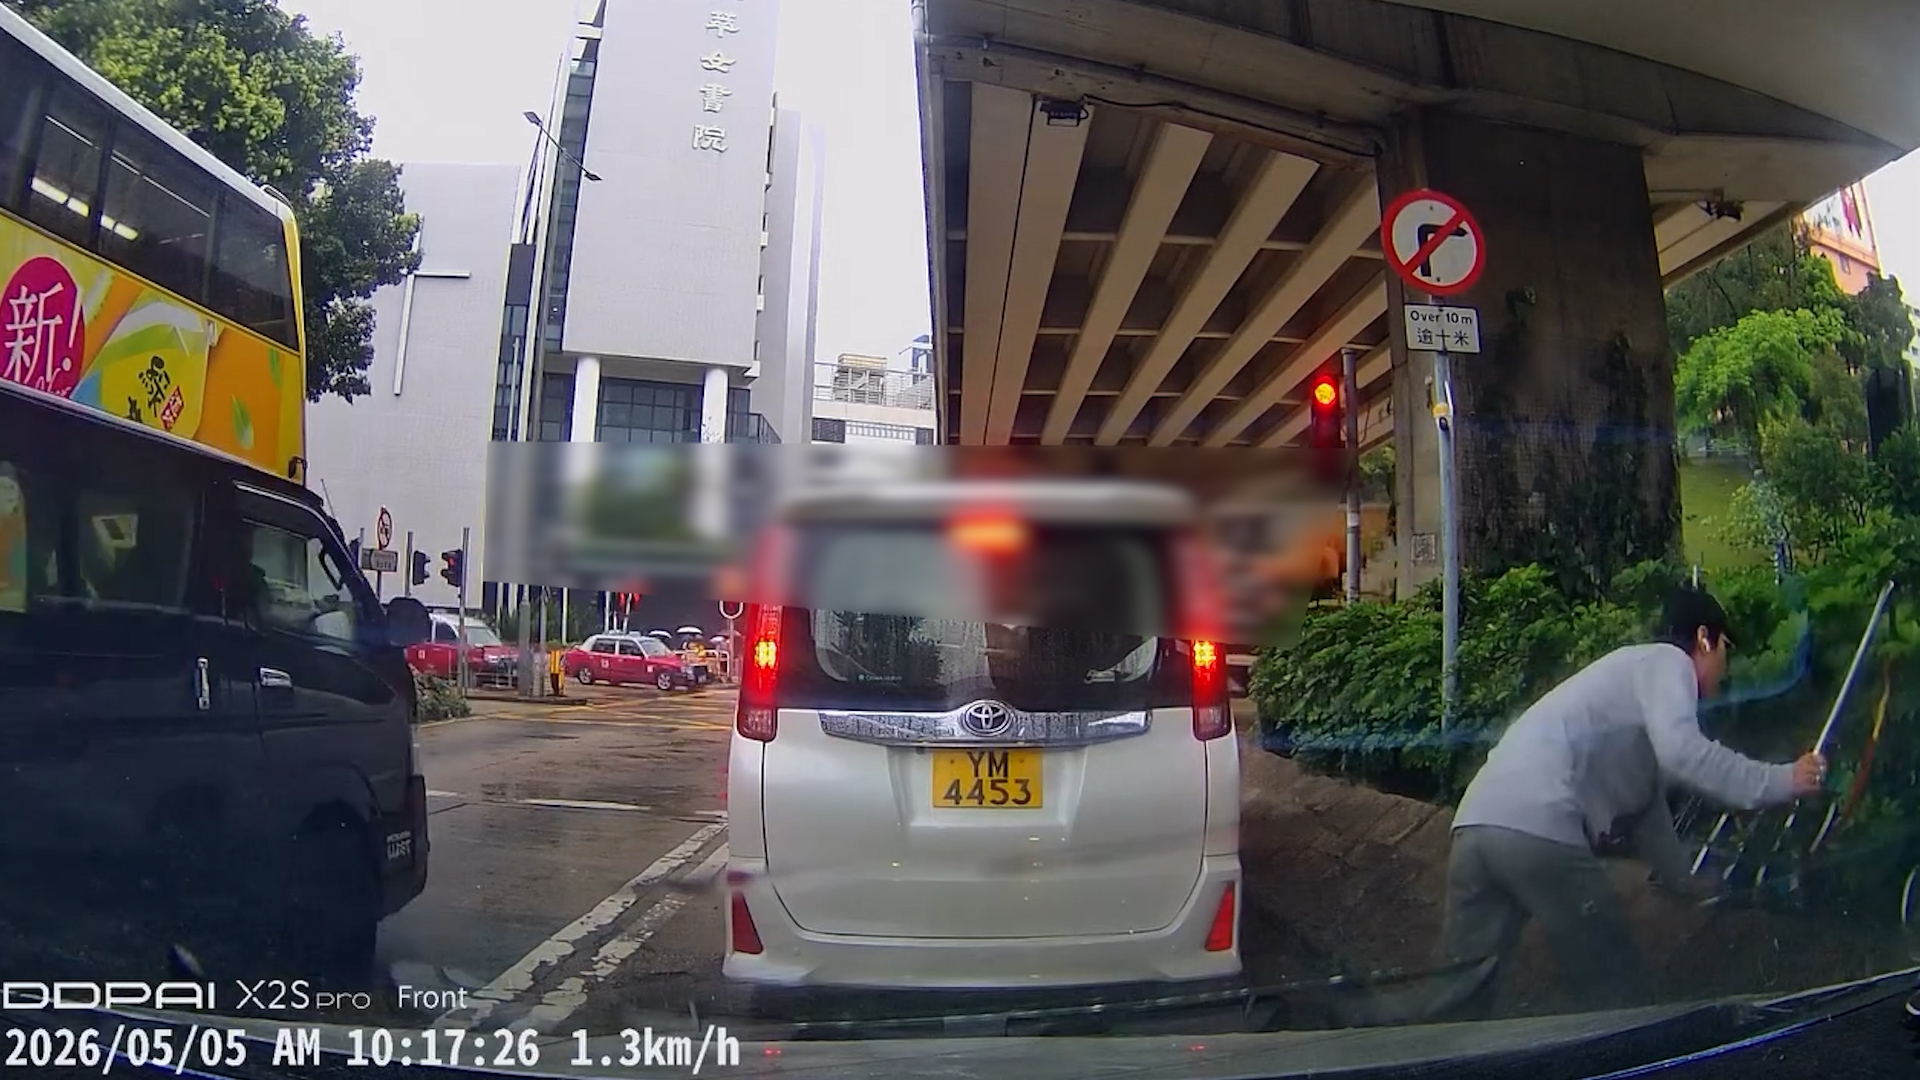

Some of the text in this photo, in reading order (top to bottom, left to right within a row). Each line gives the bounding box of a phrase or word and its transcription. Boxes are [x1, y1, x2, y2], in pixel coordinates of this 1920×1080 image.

[1410, 310, 1440, 322] Over
[1417, 327, 1469, 347] 逾十米
[966, 748, 1009, 778] YM
[943, 779, 1031, 805] 4453
